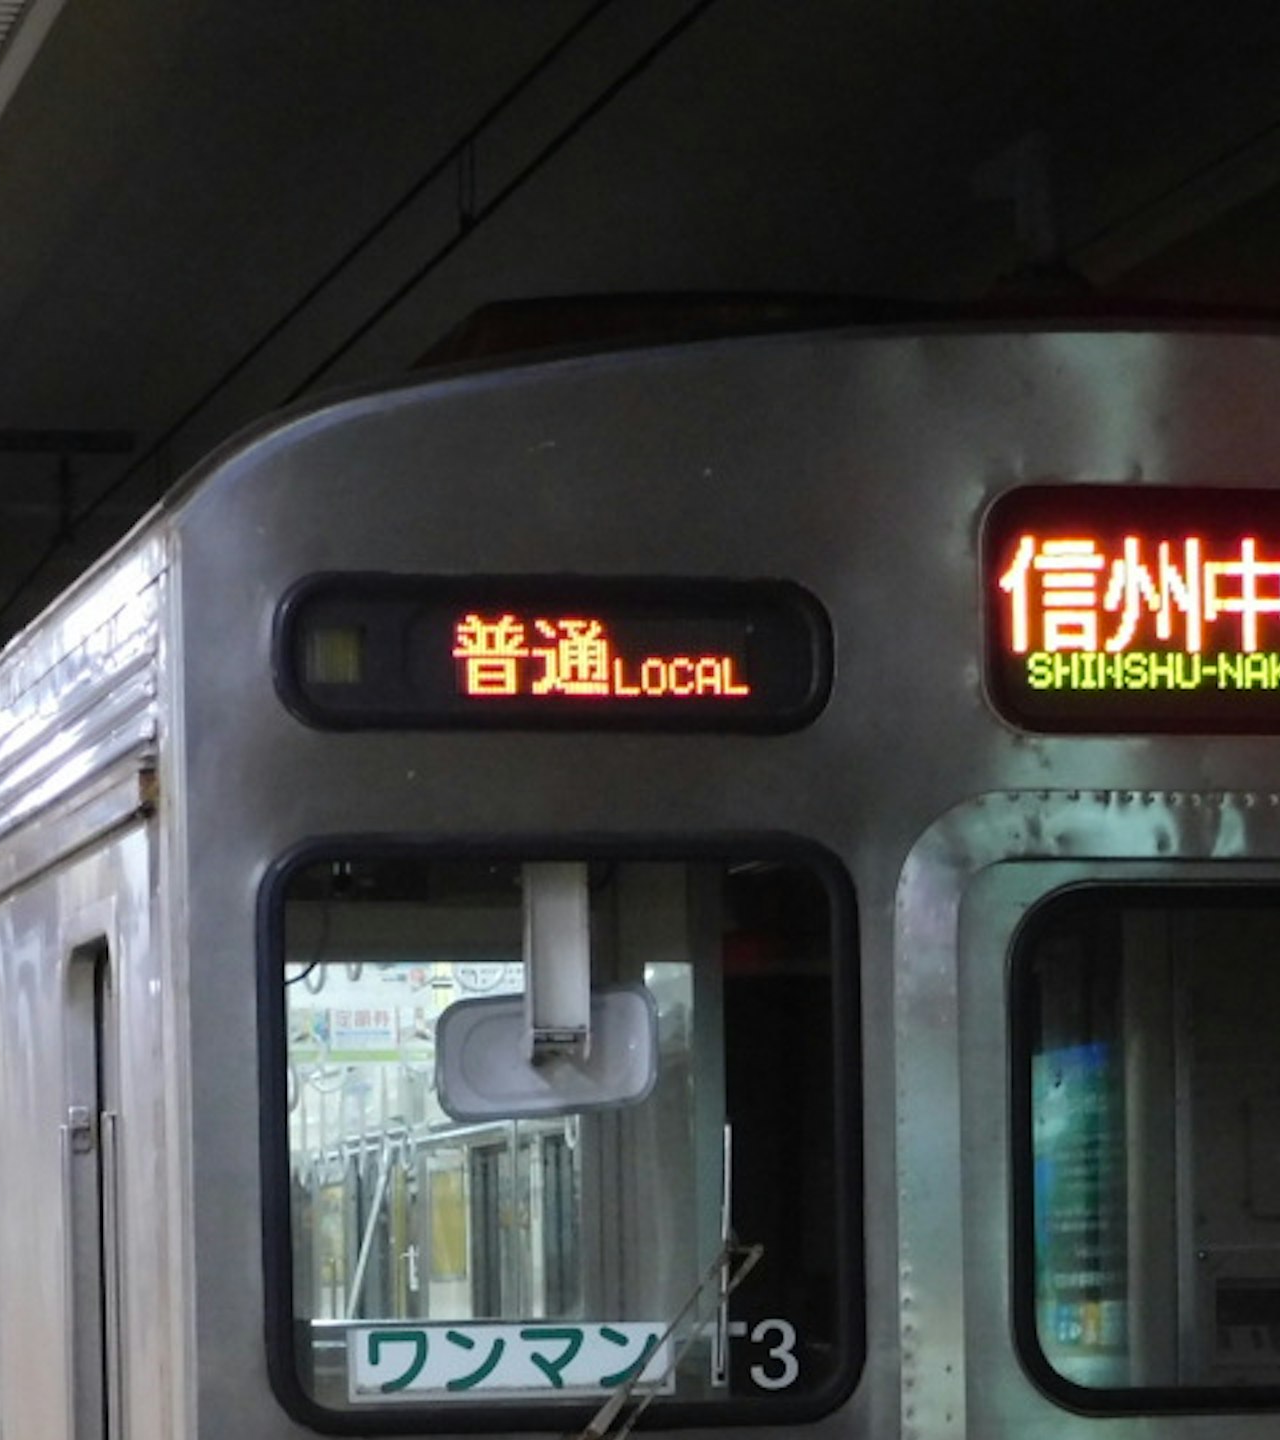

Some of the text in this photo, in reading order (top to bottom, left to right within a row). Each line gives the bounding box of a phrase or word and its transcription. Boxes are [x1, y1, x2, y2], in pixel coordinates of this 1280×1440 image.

[452, 614, 749, 695] 普通 LOCAL
[368, 1328, 658, 1393] ワンマン
